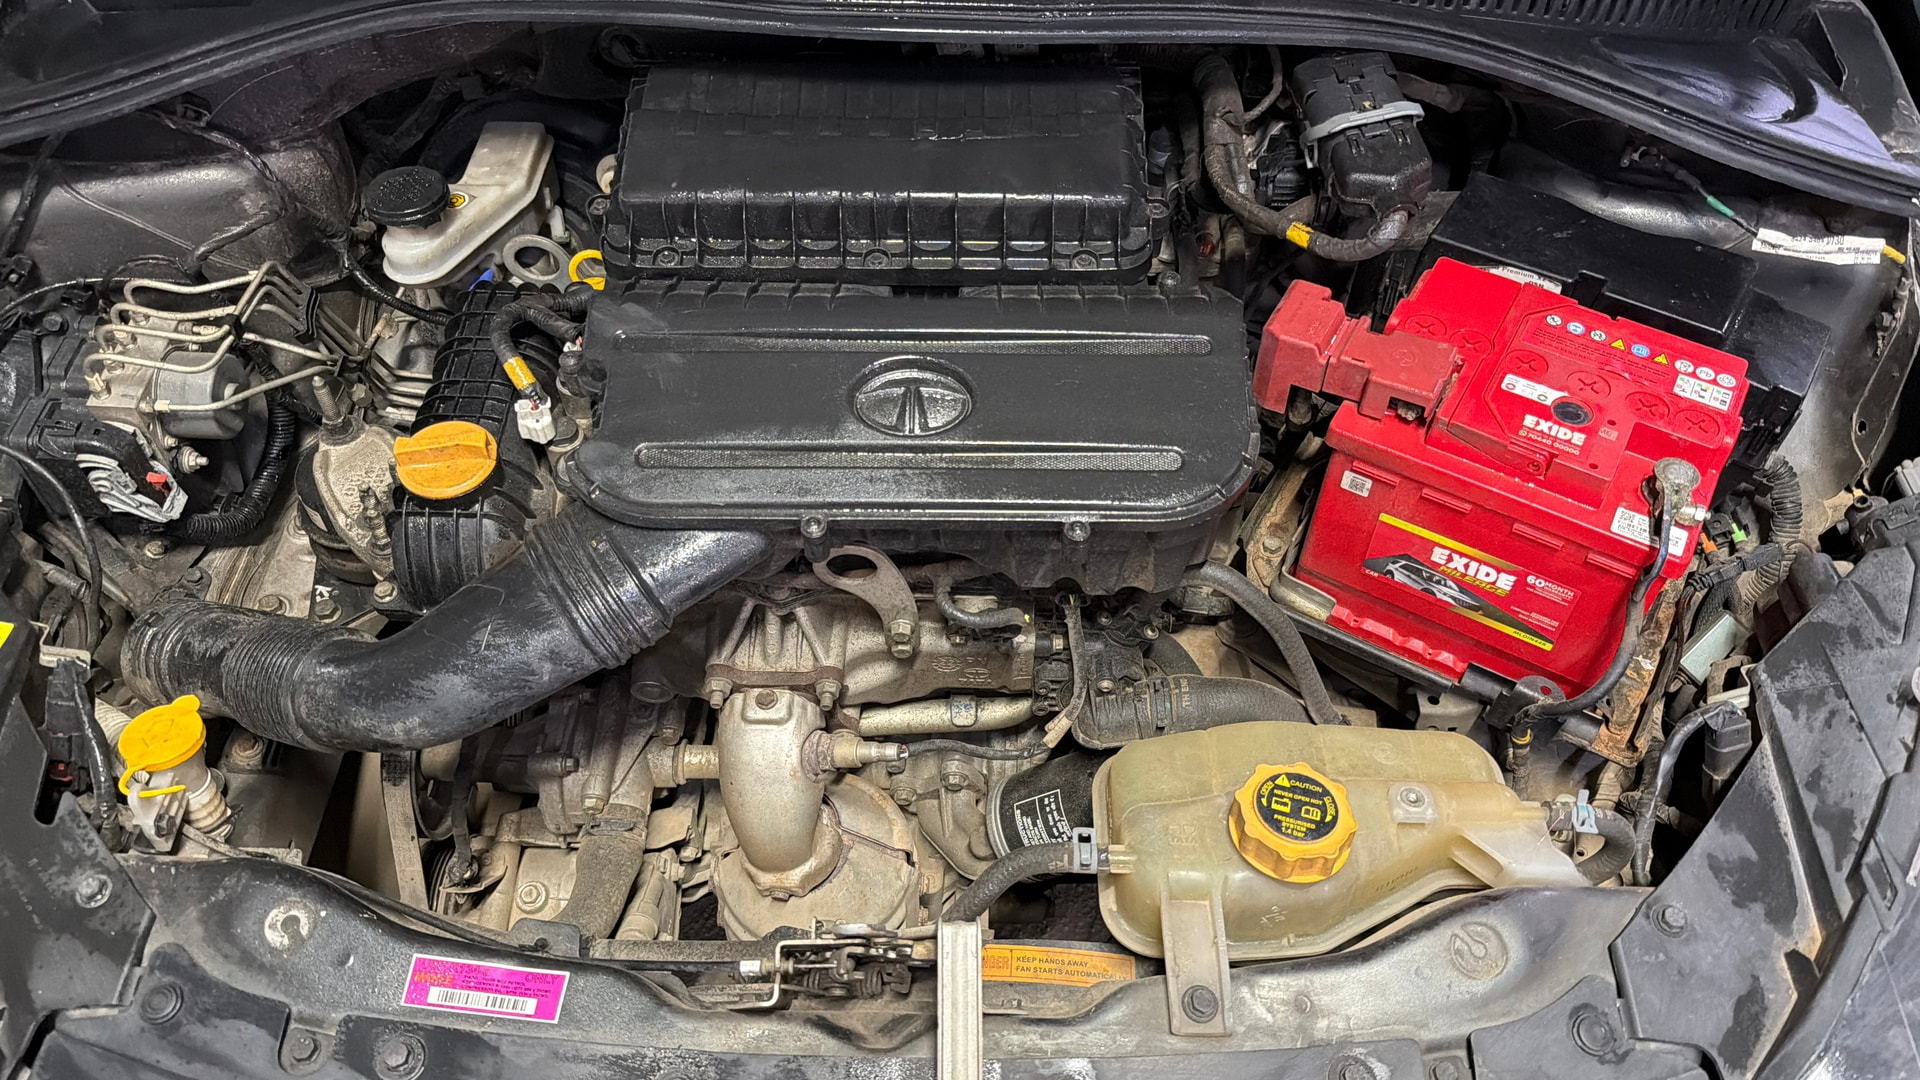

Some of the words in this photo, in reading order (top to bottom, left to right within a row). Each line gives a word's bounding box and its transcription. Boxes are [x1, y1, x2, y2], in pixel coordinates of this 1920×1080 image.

[1699, 369, 1712, 378] Pb
[1522, 413, 1586, 446] EXIDE
[1430, 545, 1518, 591] EXIDE
[1439, 565, 1510, 597] MILEAGE
[1526, 575, 1545, 588] 60
[1544, 581, 1575, 597] MONTH
[1290, 780, 1323, 793] CAUTION
[1273, 789, 1293, 798] NEVER
[1293, 794, 1310, 802] OPEN
[1325, 795, 1336, 816] CLOSE
[1016, 809, 1031, 847] TRUCTIONS
[1273, 814, 1316, 829] PRESSURISED
[1282, 821, 1307, 832] SYSTEM
[1293, 830, 1306, 838] bar
[982, 955, 1009, 969] NGER
[1016, 955, 1037, 963] KEEP
[1038, 957, 1065, 966] HANDS
[1067, 959, 1088, 968] AWAY
[1016, 965, 1031, 973] FAN
[1033, 966, 1063, 975] STARTS
